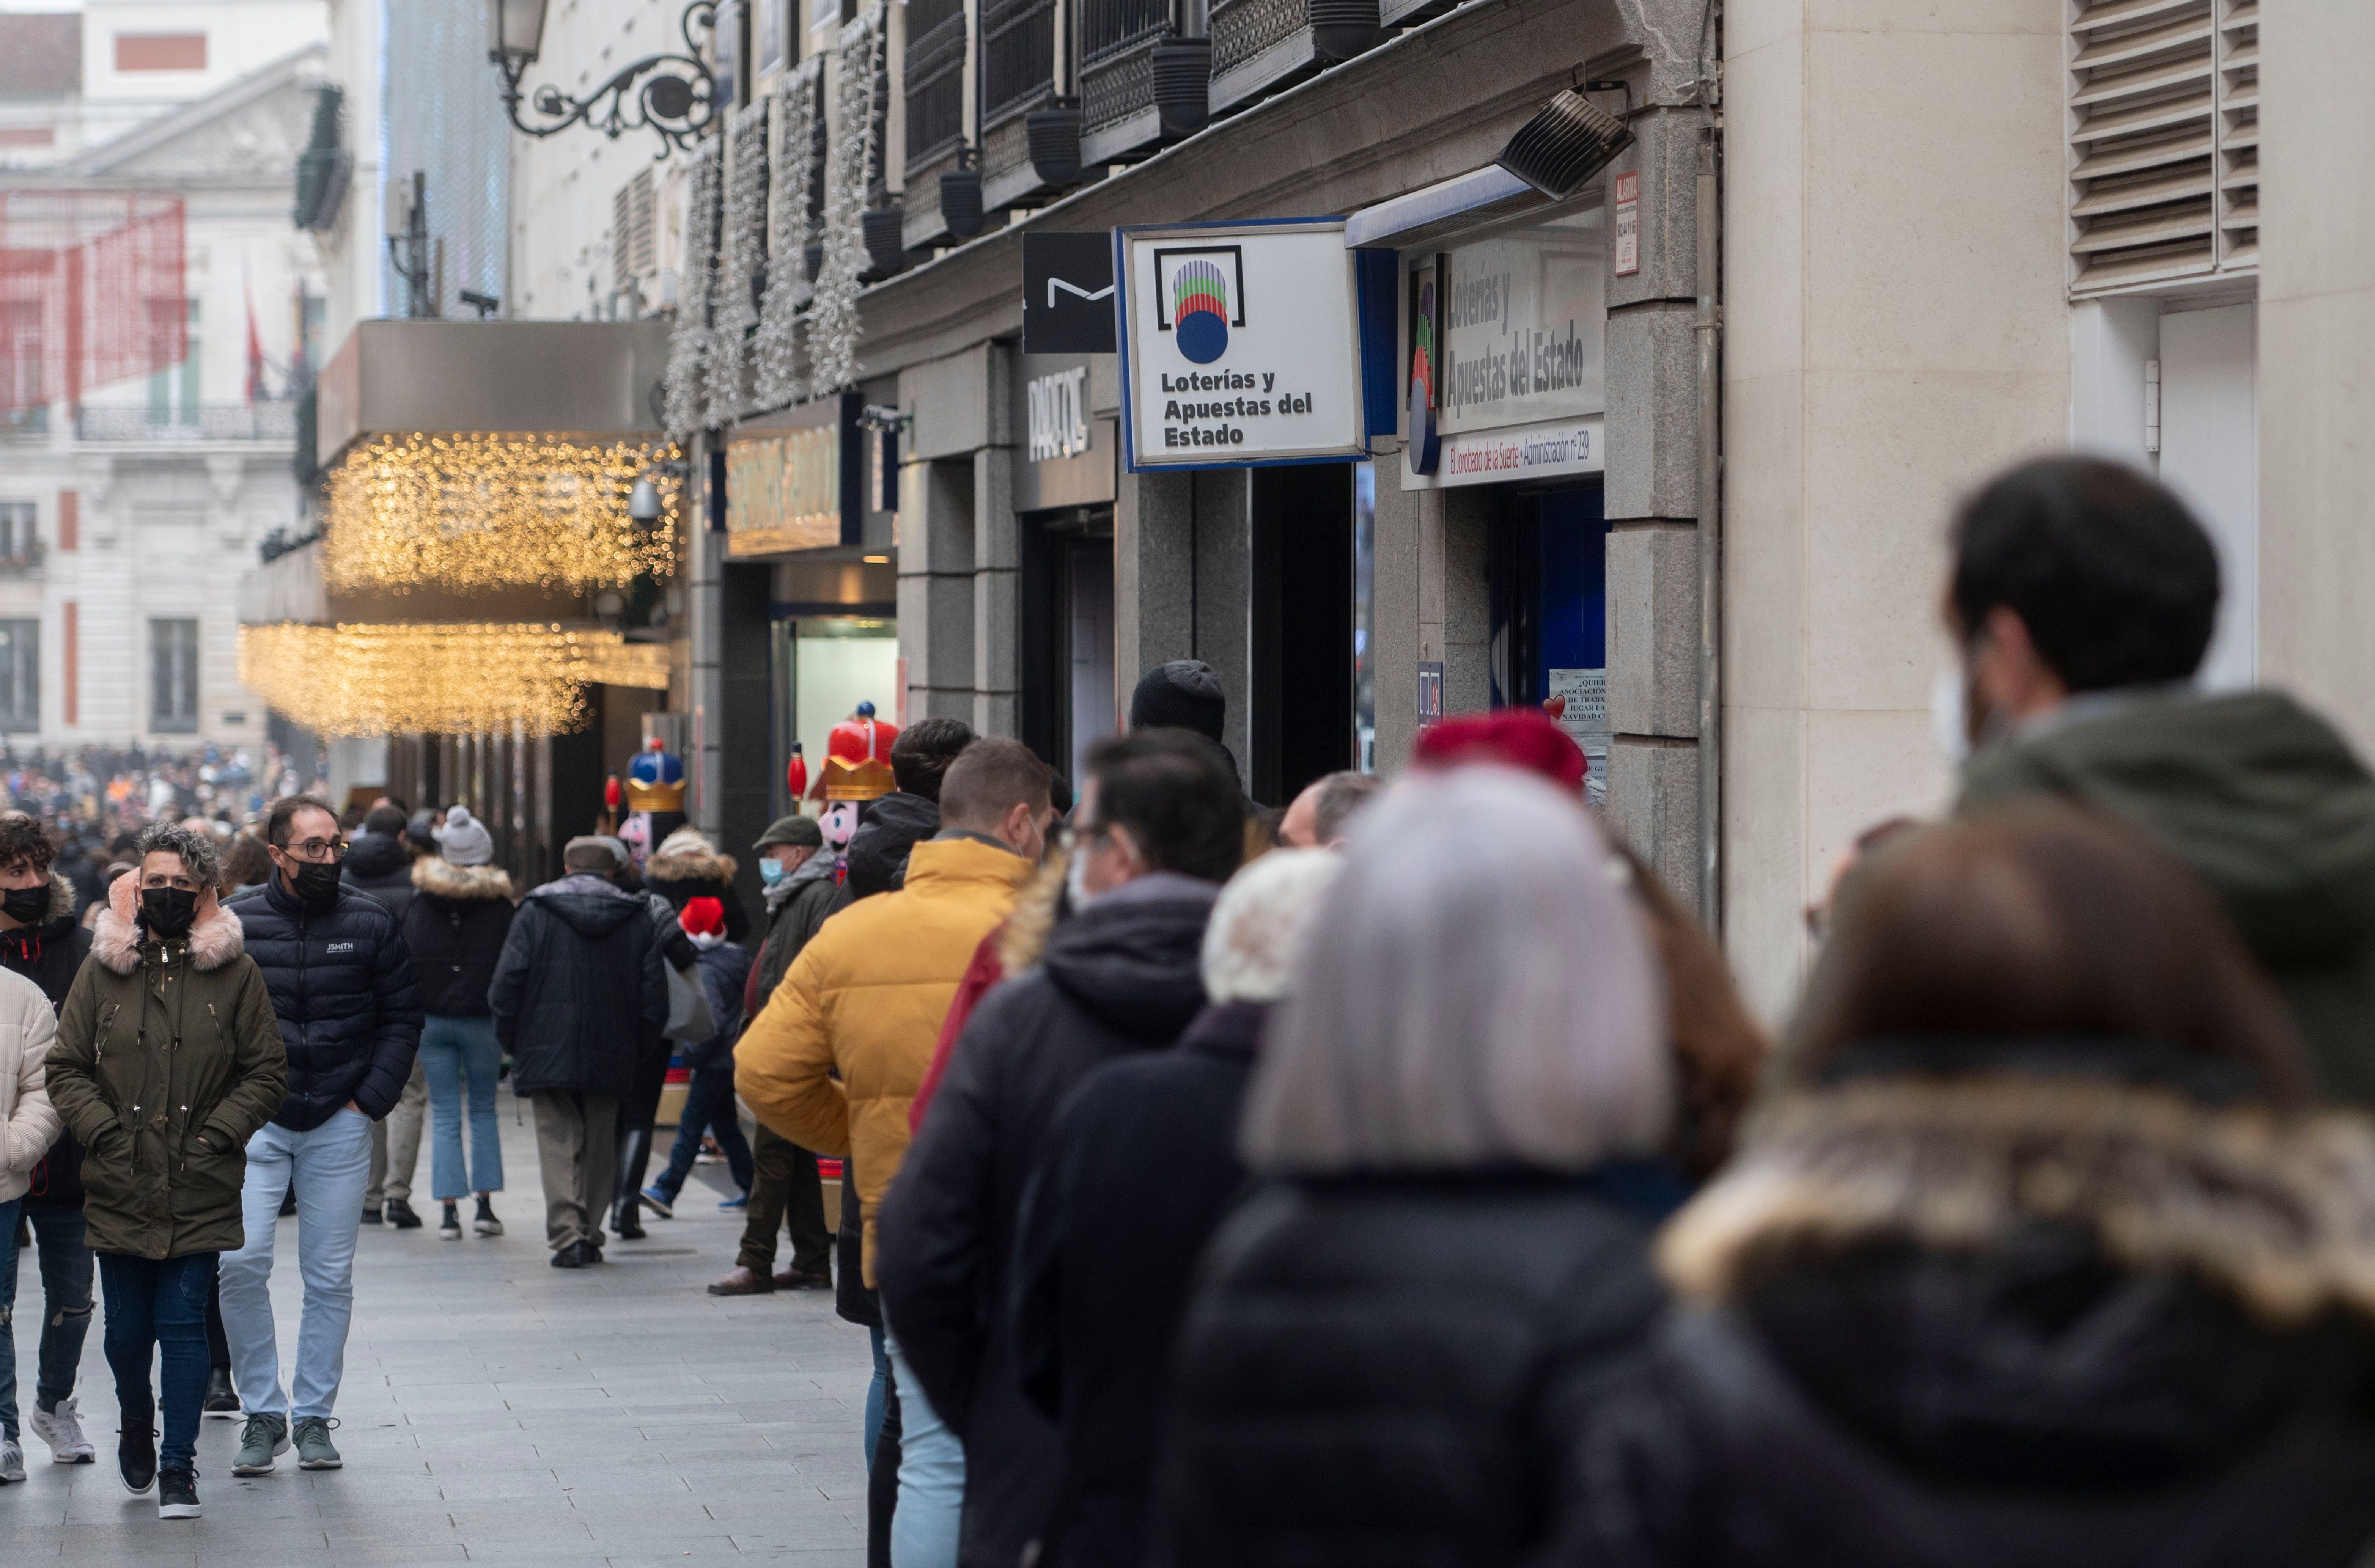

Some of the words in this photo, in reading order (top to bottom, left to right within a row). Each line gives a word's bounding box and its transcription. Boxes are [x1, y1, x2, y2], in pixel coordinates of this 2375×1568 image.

[1617, 176, 1637, 201] ALARMA
[1448, 261, 1498, 330] Loterías
[1502, 272, 1510, 336] y
[1161, 369, 1255, 392] Loterías
[1262, 372, 1275, 393] y
[1447, 342, 1506, 419] Apuestas
[1510, 328, 1530, 396] del
[1534, 319, 1583, 393] Estado
[1164, 396, 1271, 424] Apuestas
[1278, 392, 1312, 414] del
[1164, 423, 1244, 447] Estado
[1451, 446, 1455, 475] El
[1456, 442, 1482, 474] Jorobado
[1484, 441, 1492, 471] de
[1493, 441, 1498, 470] la
[1499, 441, 1519, 470] Suerte
[1524, 431, 1569, 466] Administración
[1578, 430, 1589, 460] 239
